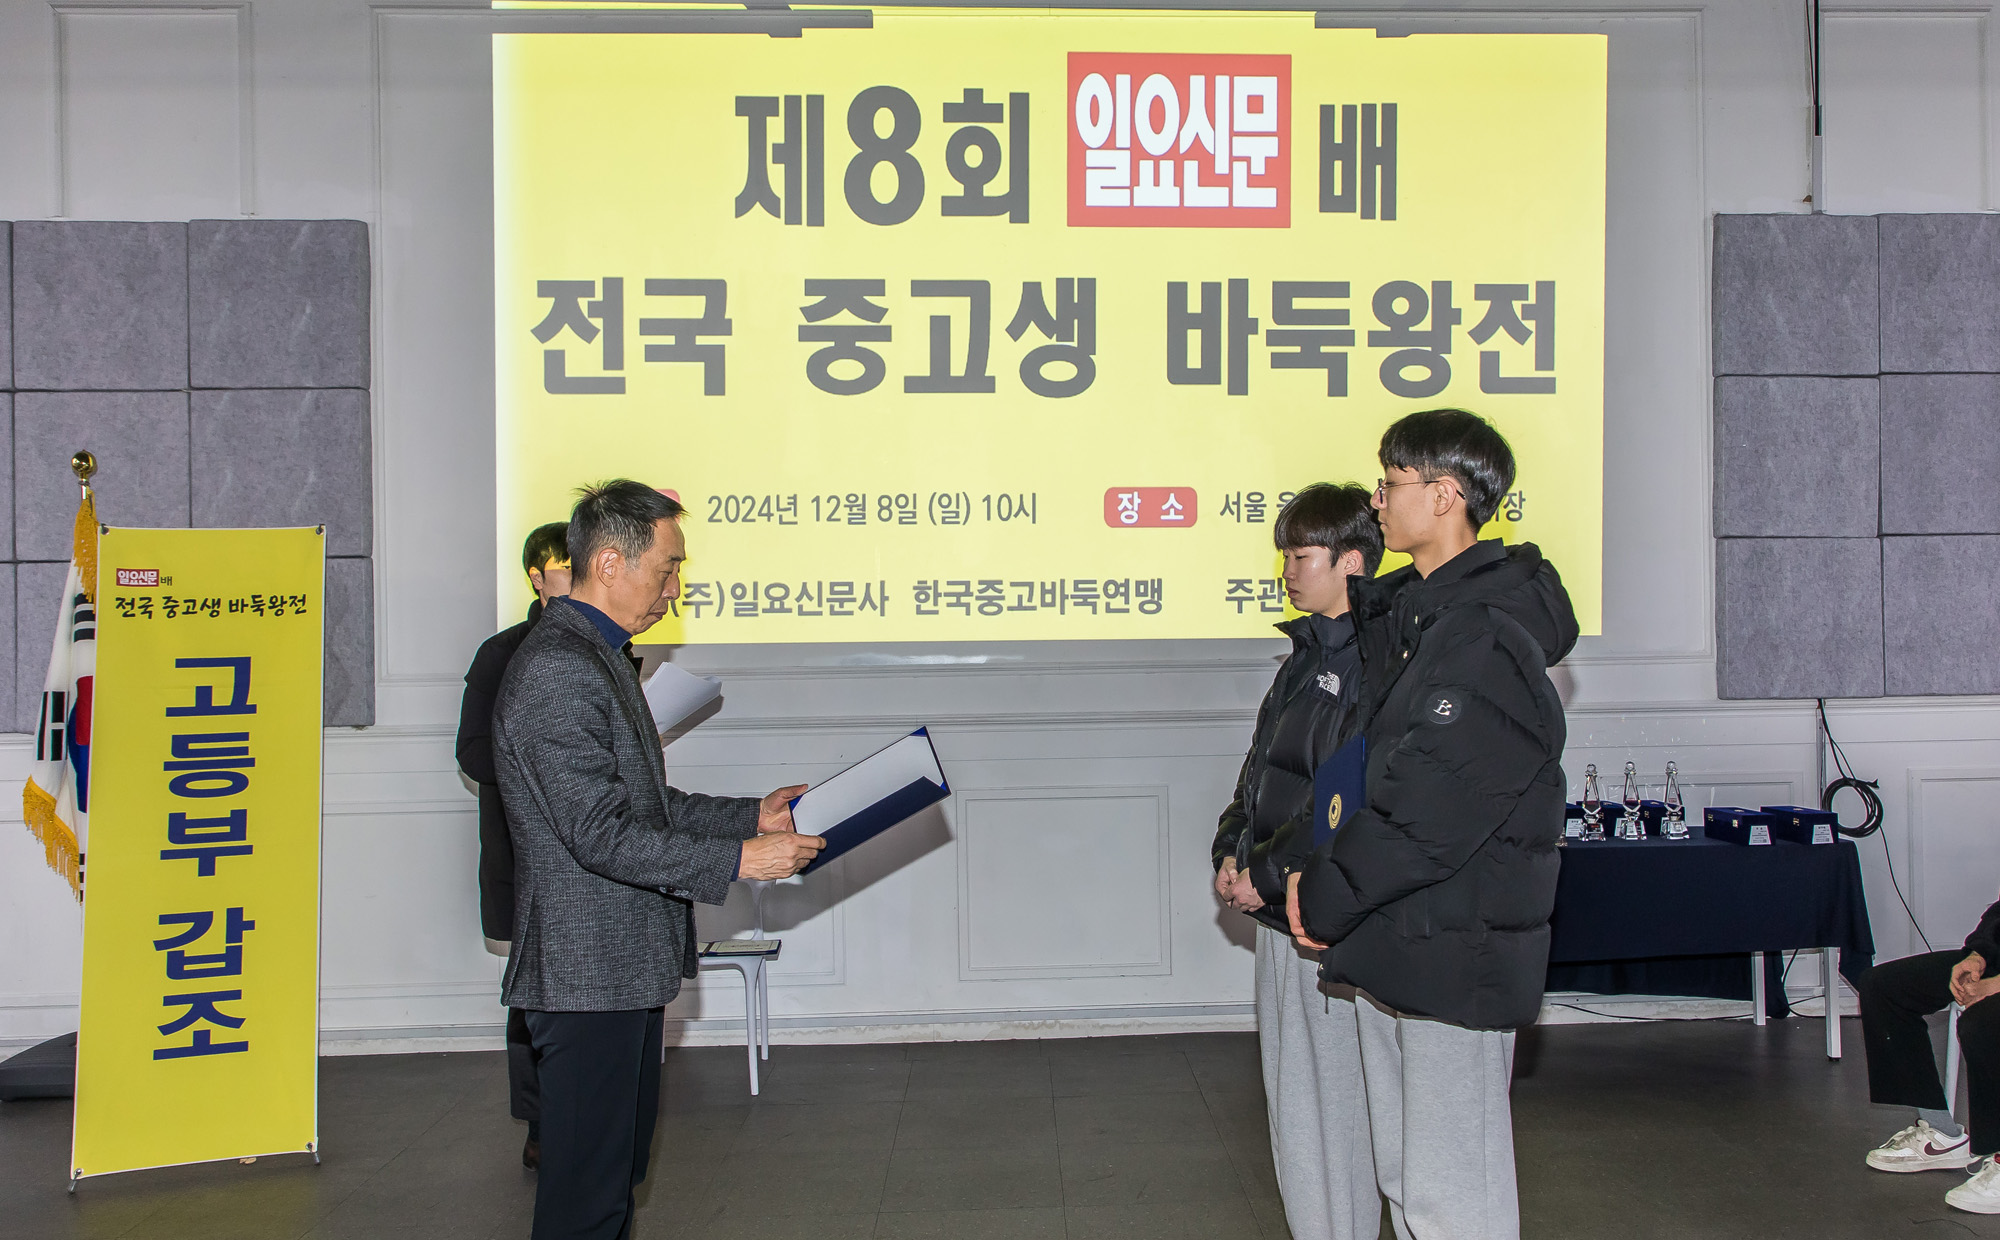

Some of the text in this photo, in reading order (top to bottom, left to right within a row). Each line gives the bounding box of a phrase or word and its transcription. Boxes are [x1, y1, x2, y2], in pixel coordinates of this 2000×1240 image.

[734, 72, 1398, 227] 제8회 일요신문 배
[530, 276, 1557, 399] 전국 중고생 바둑왕전
[706, 491, 1037, 526] 2024년 12월 8일 (일) 10시
[1219, 491, 1268, 523] 서울
[117, 570, 173, 586] 일요신문 배
[1225, 577, 1287, 614] 주관
[115, 594, 307, 620] 전국 중고생 바둑왕전
[912, 578, 1163, 616] 한국중고바둑연맹
[152, 656, 258, 1061] 고등부 갑조
